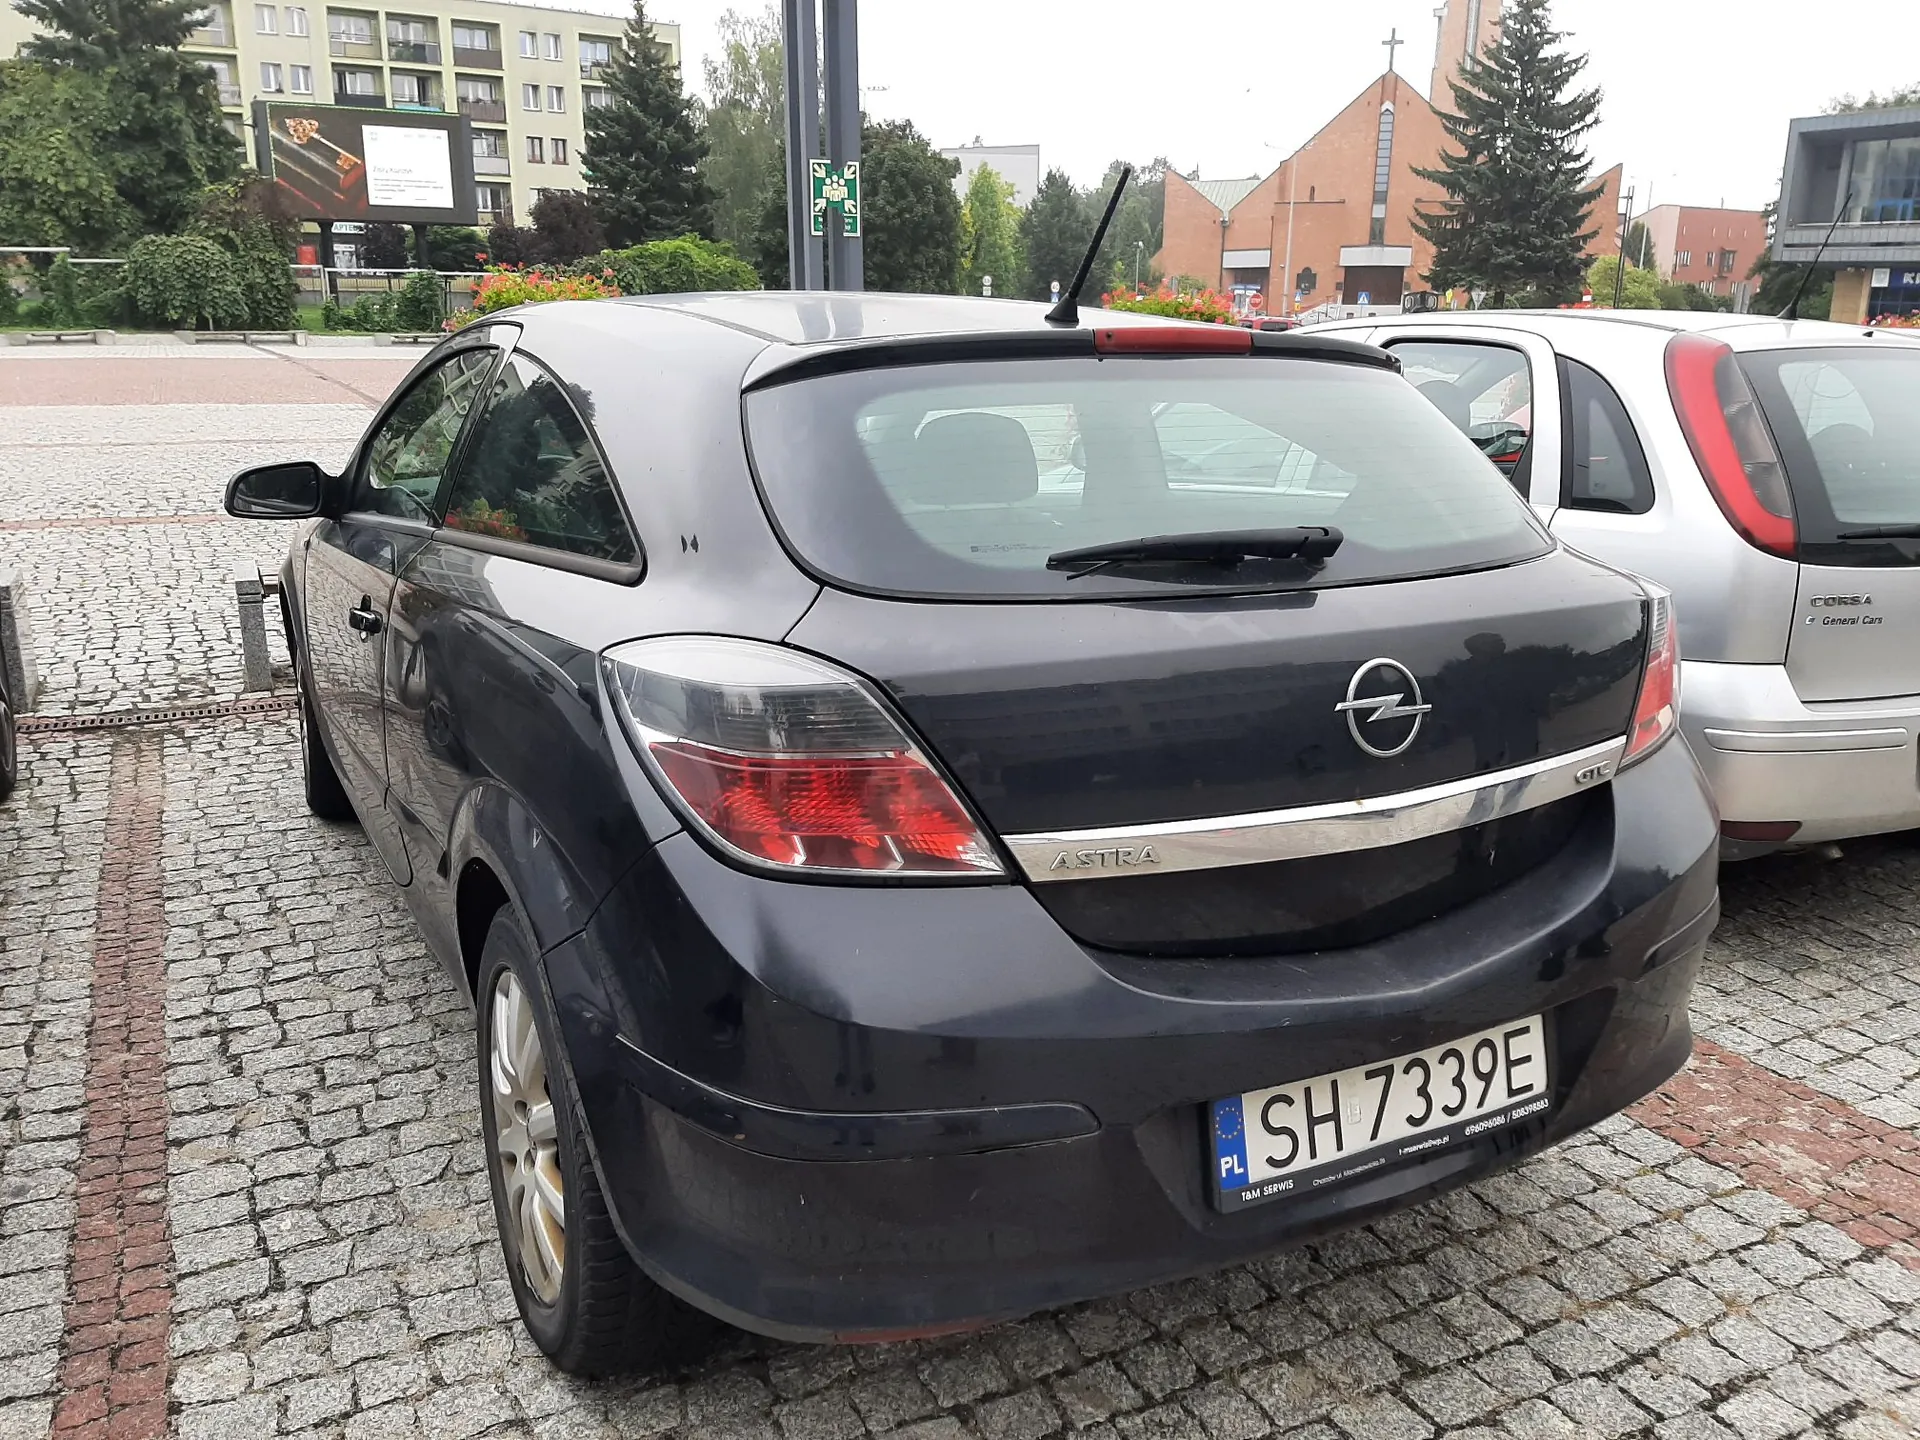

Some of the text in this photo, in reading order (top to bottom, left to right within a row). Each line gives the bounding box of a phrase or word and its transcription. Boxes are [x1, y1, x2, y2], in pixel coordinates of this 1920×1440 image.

[1810, 593, 1873, 607] CORSA
[1822, 616, 1884, 625] General Cars
[1049, 845, 1161, 871] ASTRA
[1260, 1025, 1535, 1168] SH 7339E
[1220, 1154, 1244, 1178] PL
[1241, 1188, 1261, 1202] T&M
[1263, 1179, 1294, 1196] SERWIS
